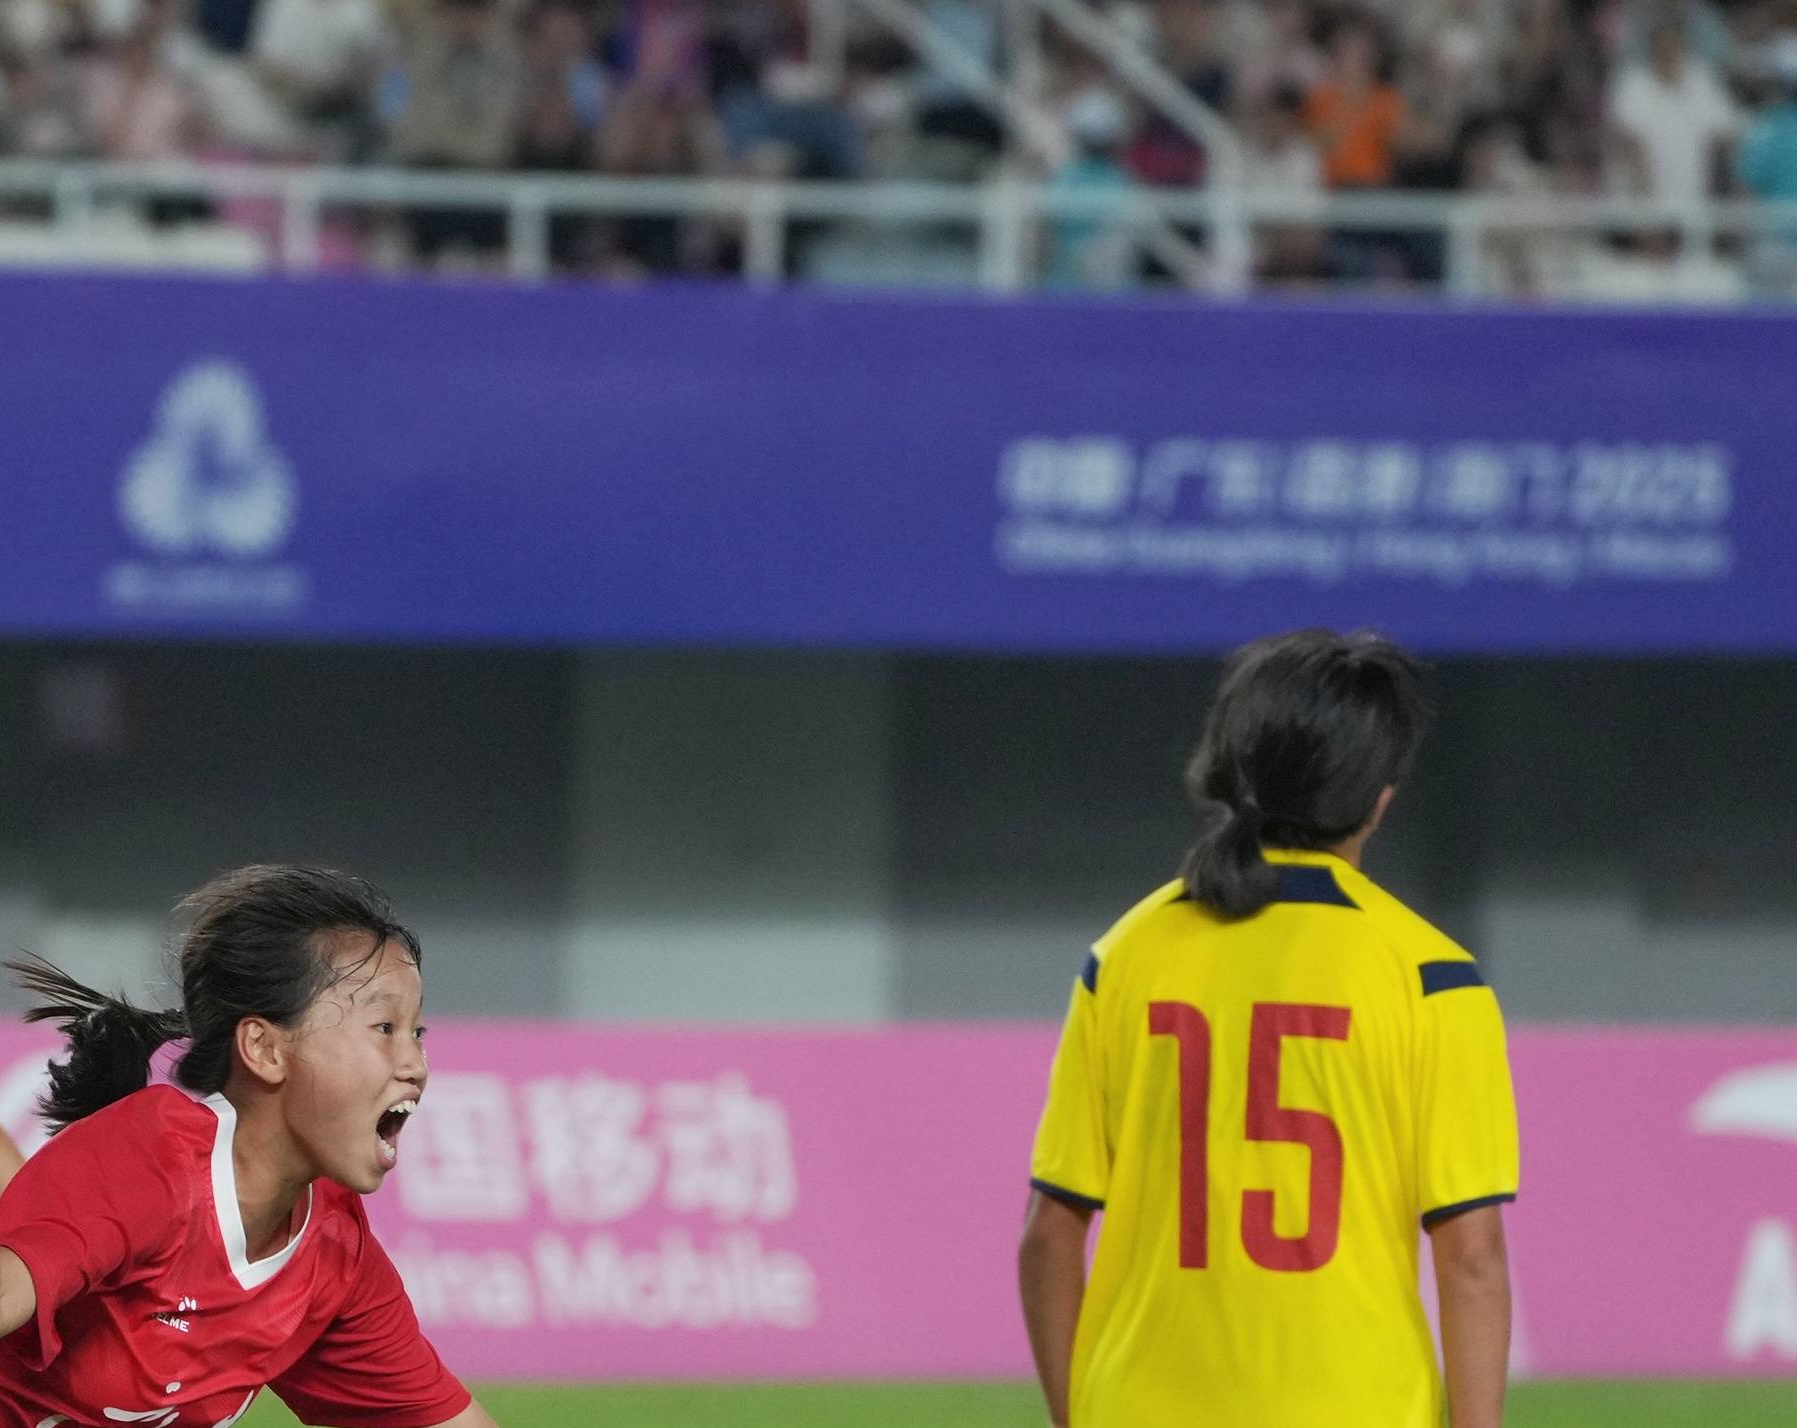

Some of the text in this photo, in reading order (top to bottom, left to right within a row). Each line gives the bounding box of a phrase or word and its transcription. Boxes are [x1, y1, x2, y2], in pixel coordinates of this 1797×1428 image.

[1147, 1001, 1352, 1273] 15
[155, 1311, 190, 1333] ELME
[533, 1229, 815, 1328] Mobile
